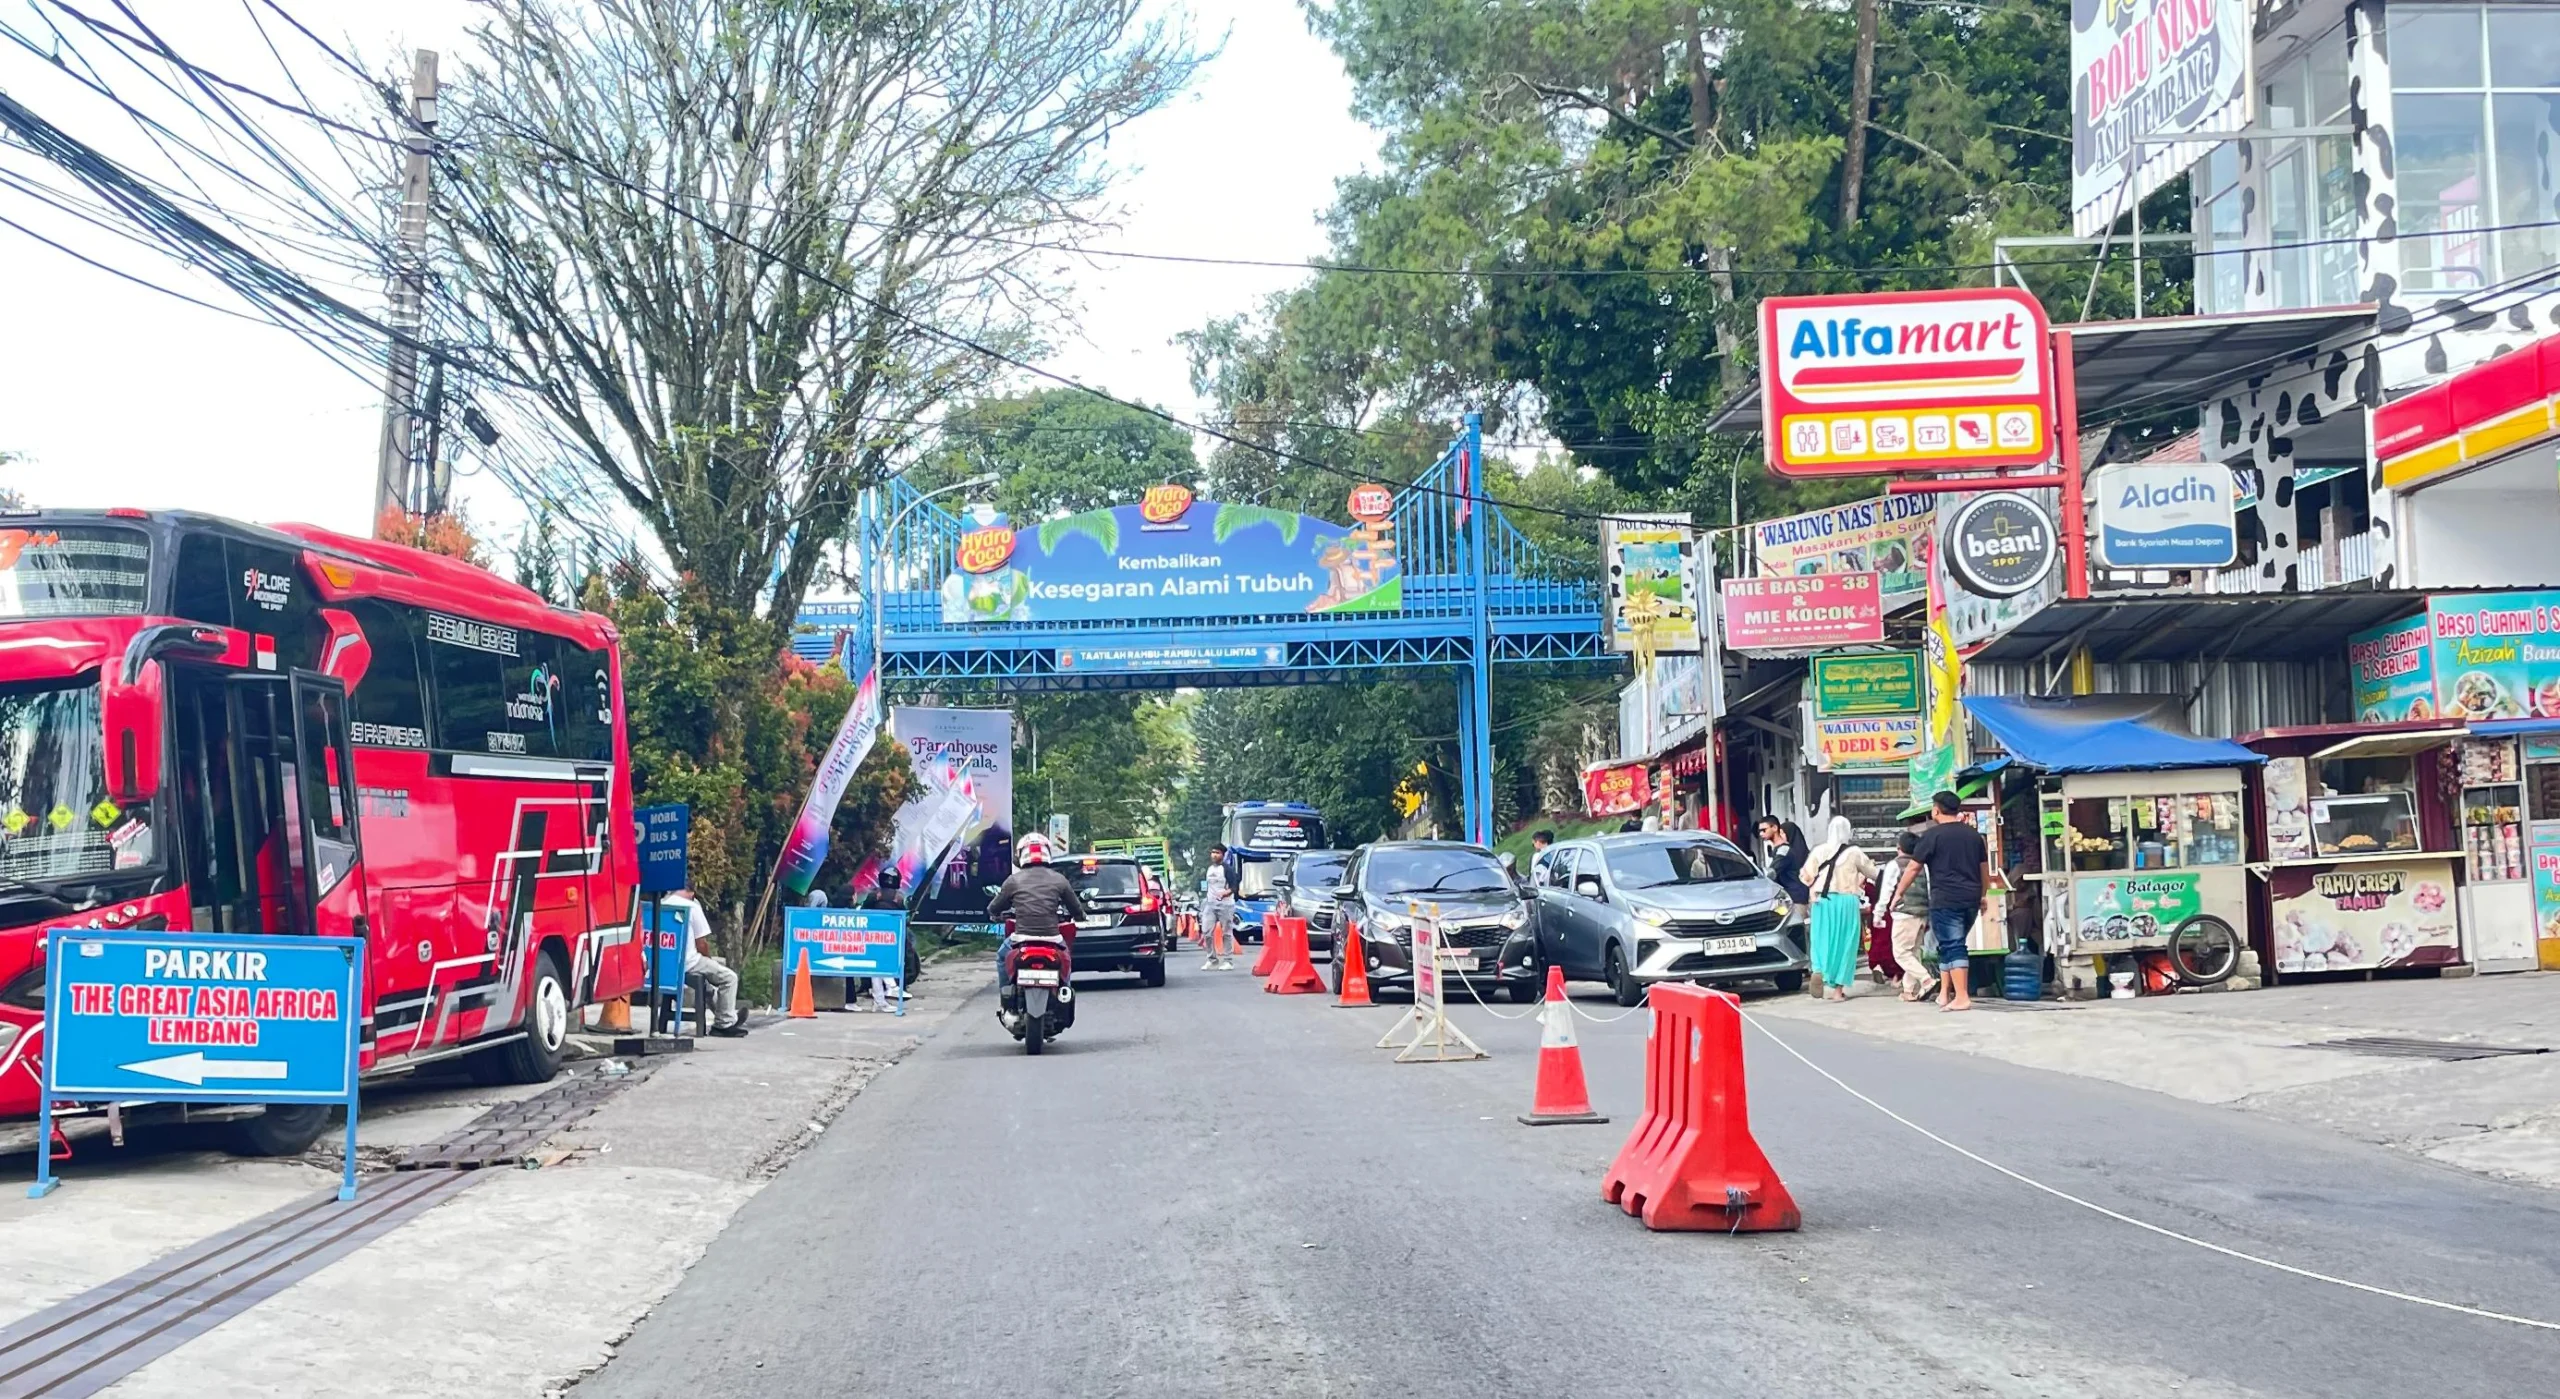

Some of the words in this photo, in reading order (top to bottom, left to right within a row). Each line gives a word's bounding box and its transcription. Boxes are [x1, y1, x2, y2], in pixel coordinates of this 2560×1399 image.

[2089, 16, 2149, 121] BOLU
[2133, 45, 2214, 136] LEMBANG
[1790, 312, 2023, 359] Alfamart
[1144, 487, 1189, 504] Hydro
[2119, 475, 2216, 509] Aladin
[1144, 500, 1183, 520] Coco
[1762, 513, 1834, 548] WARUNG
[1837, 504, 1878, 533] NASI
[961, 529, 1012, 552] Hydro
[1792, 538, 1853, 556] Masakan
[1966, 526, 2042, 557] bean!
[2115, 538, 2137, 547] Bank
[2138, 538, 2169, 548] Syariah
[2171, 538, 2194, 546] Masa
[2195, 537, 2224, 547] Depan
[962, 546, 1007, 573] Coco
[1118, 552, 1222, 571] Kembalikan
[1992, 556, 2022, 567] SPOT
[244, 568, 291, 597] EXPLORE
[1029, 579, 1154, 602] Kesegaran
[1160, 575, 1230, 597] Alami
[1235, 572, 1313, 593] Tubuh
[1728, 582, 1765, 597] MIE
[1769, 578, 1825, 594] BASO
[1841, 575, 1870, 591] 38
[1792, 594, 1807, 607] &
[1744, 609, 1781, 625] MIE
[1785, 605, 1857, 623] KOCOK
[1223, 647, 1257, 657] LINTAS
[1823, 722, 1881, 734] WARUNG
[1885, 720, 1917, 732] NASI
[1838, 738, 1876, 753] DEDI
[1880, 737, 1890, 751] S
[650, 811, 679, 824] MOBIL
[650, 831, 669, 843] BUS
[671, 830, 678, 841] &
[650, 849, 682, 861] MOTOR
[2126, 880, 2185, 895] Batagor
[2315, 874, 2352, 896] TAHU
[2356, 871, 2407, 893] CRISPY
[2335, 894, 2387, 910] FAMILY
[822, 914, 869, 928] PARKIR
[795, 929, 810, 941] THE
[812, 930, 839, 943] GREAT
[841, 931, 862, 944] ASIA
[864, 931, 897, 944] AFRICA
[1717, 939, 1736, 949] 1511
[824, 943, 865, 954] LEMBANG
[144, 948, 268, 981] PARKIR
[70, 984, 114, 1015] THE
[118, 985, 193, 1018] GREAT
[195, 987, 252, 1019] ASIA
[253, 990, 338, 1020] AFRICA
[148, 1020, 259, 1046] LEMBANG
